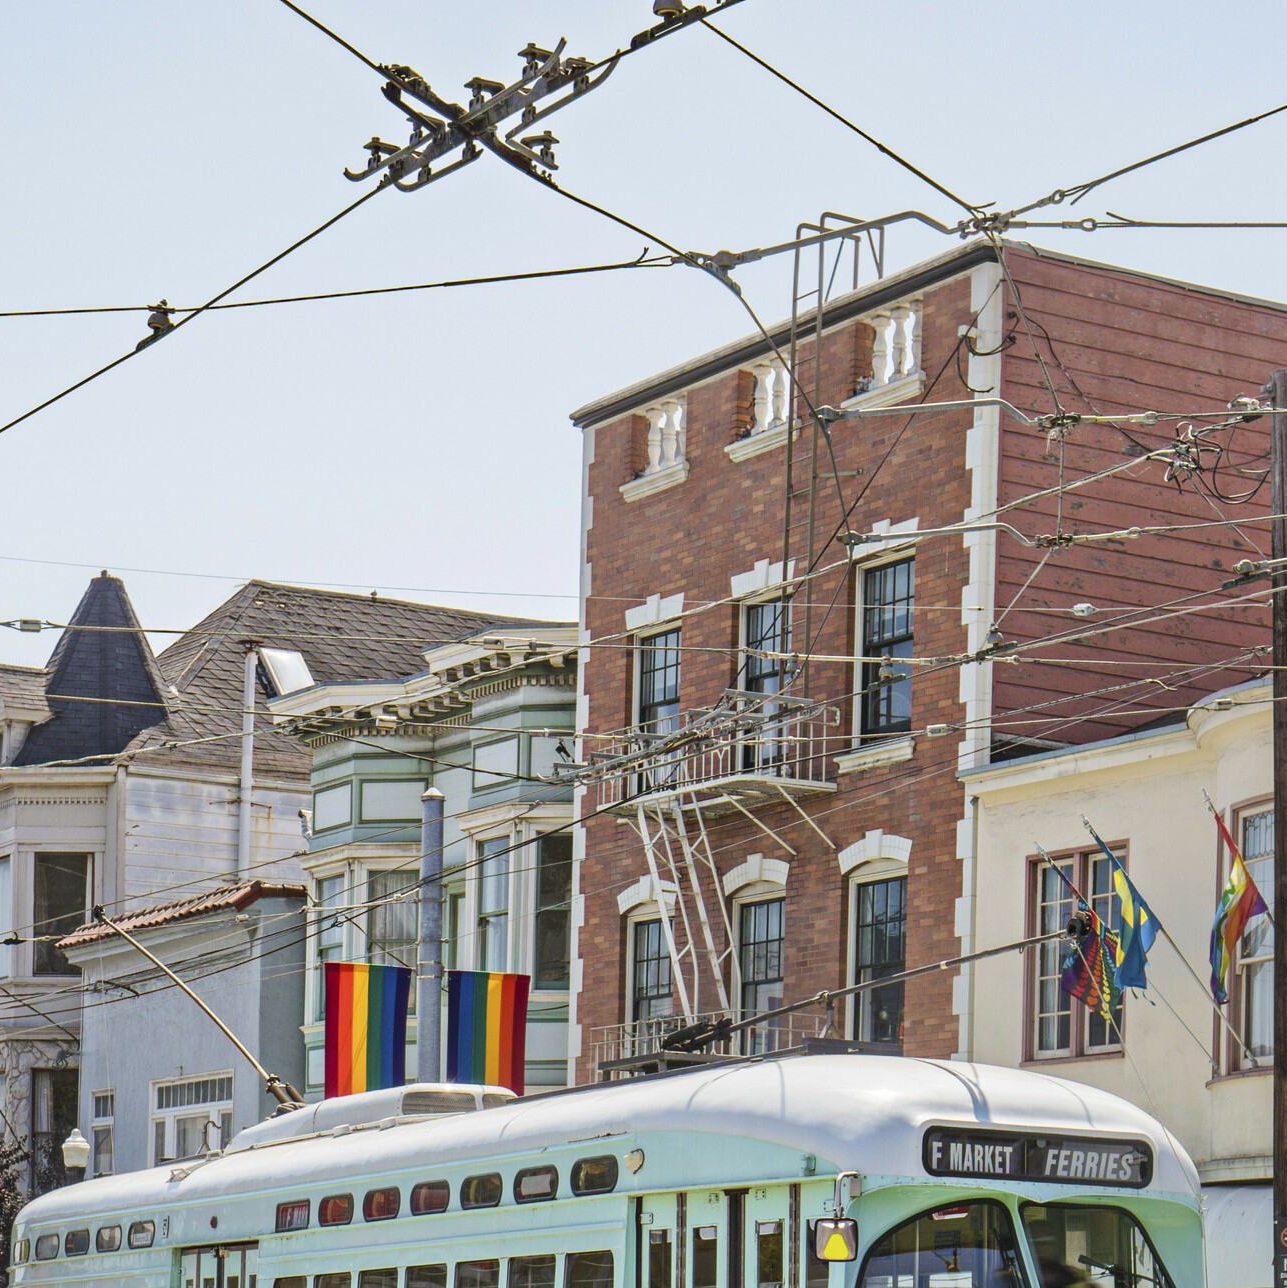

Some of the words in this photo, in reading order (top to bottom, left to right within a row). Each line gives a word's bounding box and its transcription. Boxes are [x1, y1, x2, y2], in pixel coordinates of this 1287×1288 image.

[931, 1141, 942, 1169] F
[949, 1142, 1013, 1174] MARKET
[1044, 1149, 1133, 1181] FERRIES
